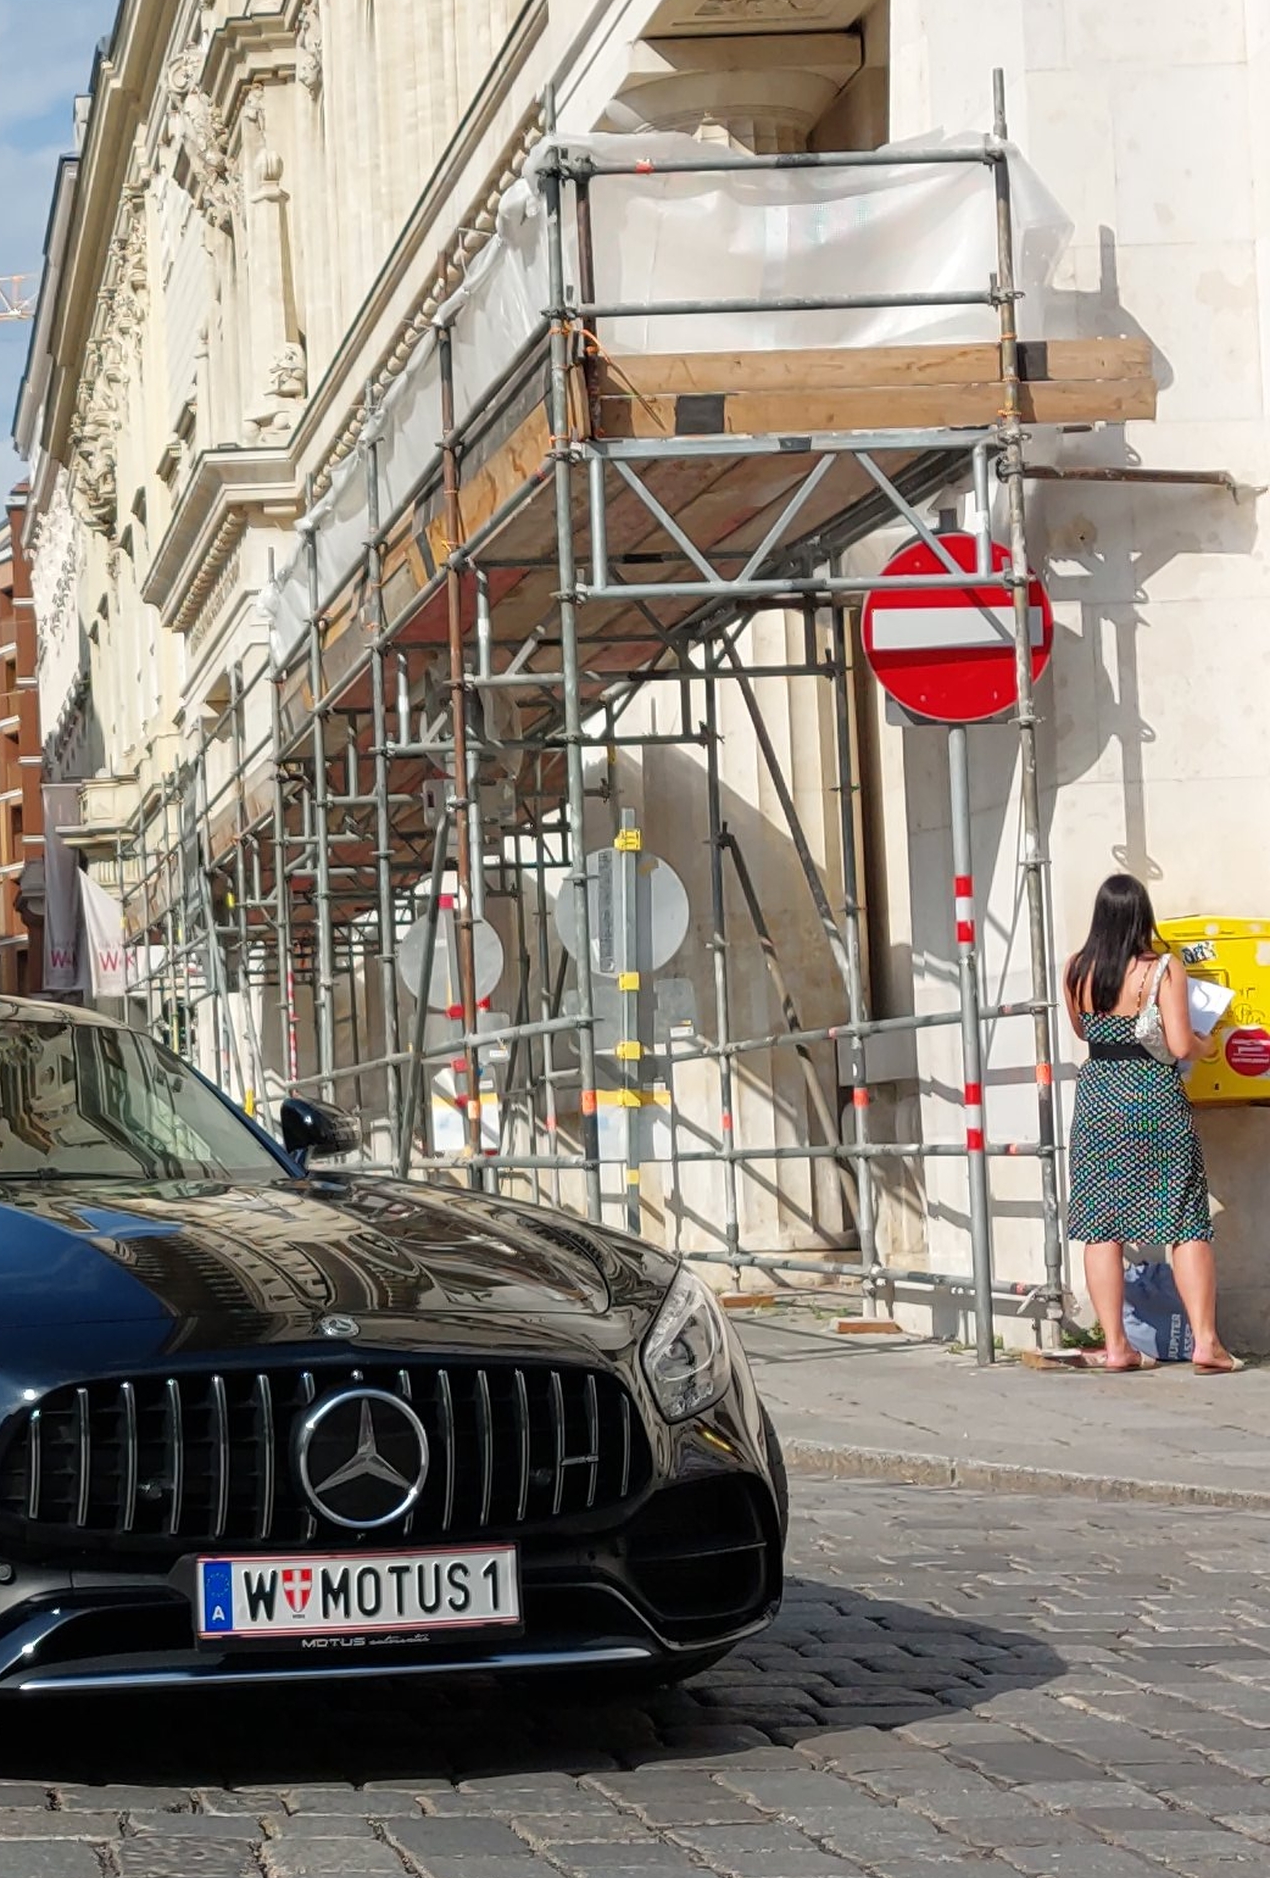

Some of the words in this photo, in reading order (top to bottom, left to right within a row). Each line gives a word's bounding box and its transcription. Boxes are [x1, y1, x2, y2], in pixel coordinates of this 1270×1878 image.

[242, 1569, 279, 1622] W
[211, 1605, 225, 1621] A
[301, 1636, 366, 1648] MOTUS
